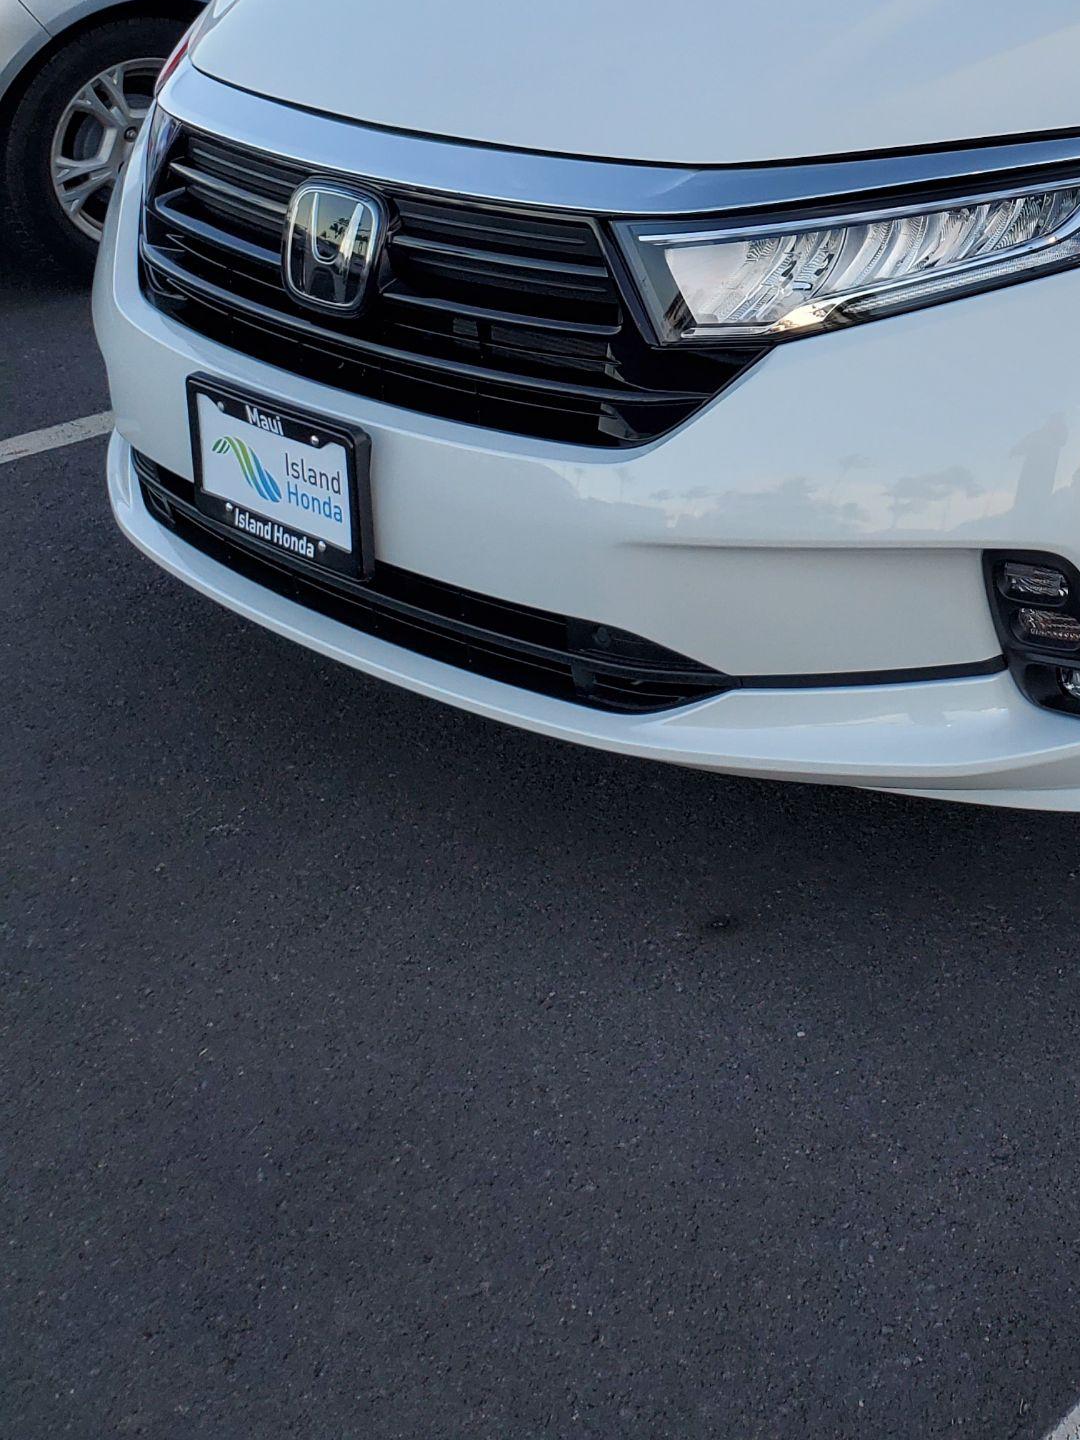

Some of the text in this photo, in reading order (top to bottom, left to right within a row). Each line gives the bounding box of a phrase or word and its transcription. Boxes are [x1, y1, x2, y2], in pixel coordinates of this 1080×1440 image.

[245, 404, 284, 436] Maui
[285, 452, 341, 495] Island
[287, 481, 343, 523] Honda
[235, 508, 315, 558] Island Honda
